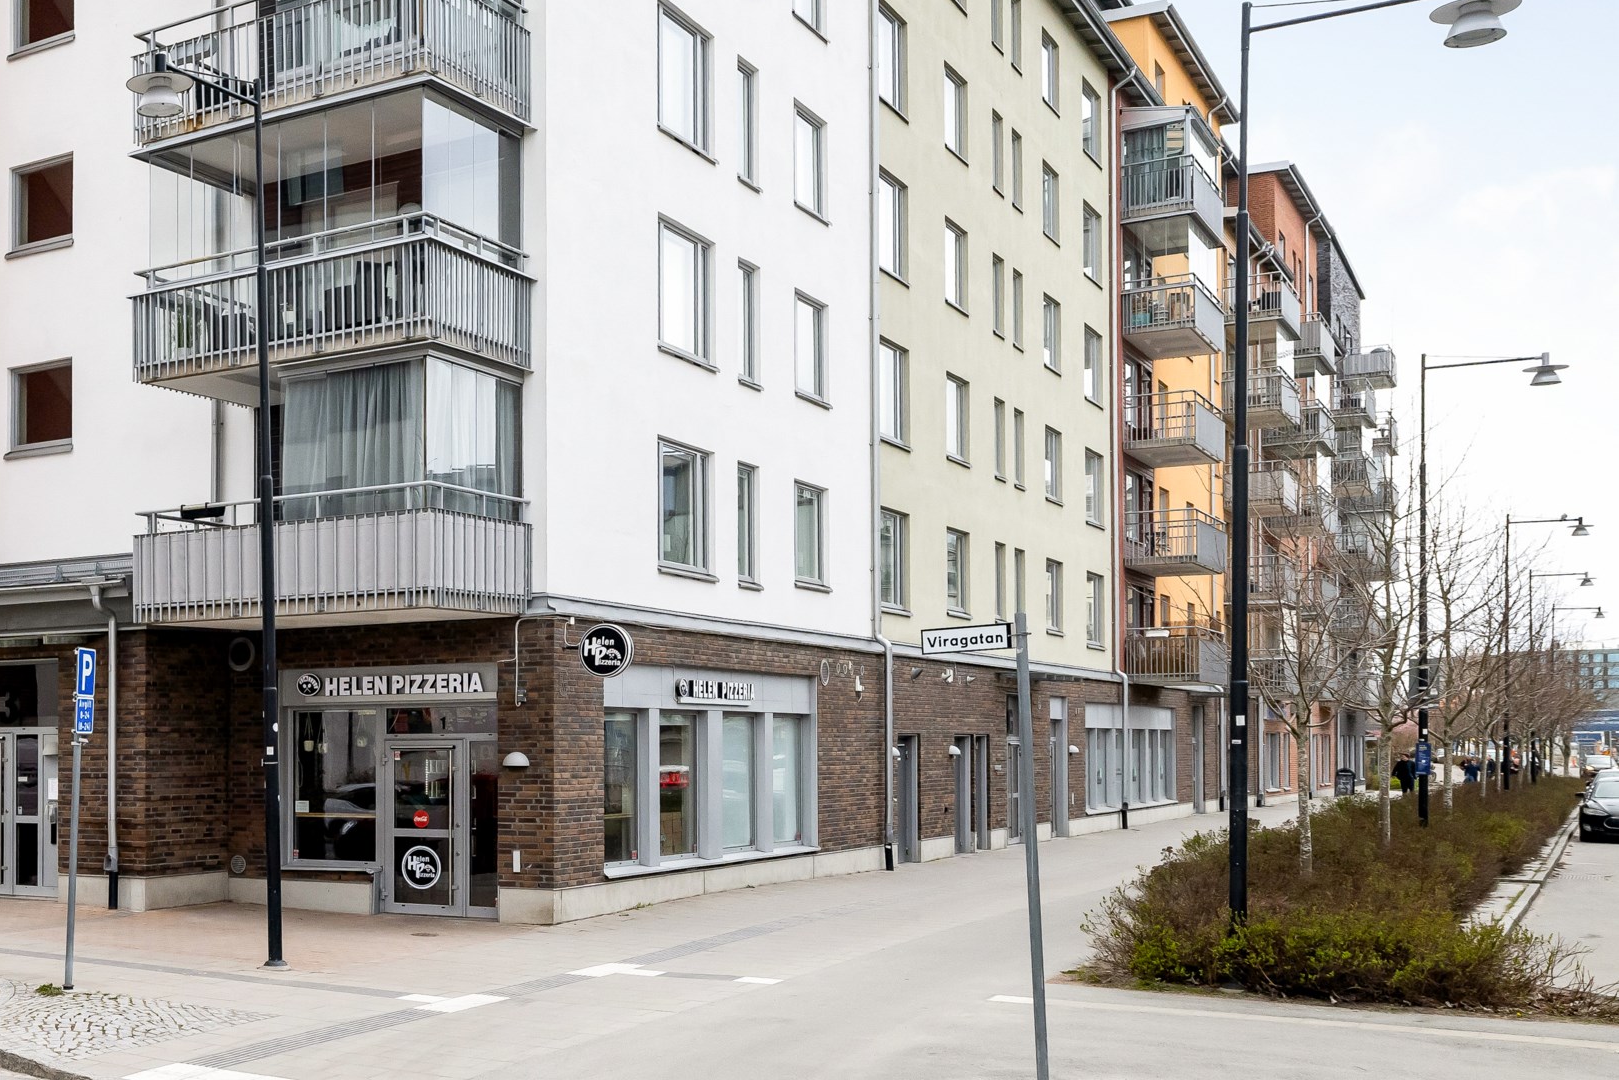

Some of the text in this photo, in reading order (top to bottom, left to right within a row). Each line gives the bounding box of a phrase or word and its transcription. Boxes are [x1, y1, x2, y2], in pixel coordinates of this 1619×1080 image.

[583, 635, 615, 657] Helen
[926, 633, 1004, 648] Viragatan
[594, 646, 621, 666] Pizzeria
[81, 653, 93, 691] P
[324, 672, 483, 697] HELEN PIZZERIA
[693, 679, 755, 700] HELEN PIZZERIA
[78, 700, 92, 710] Avgift
[440, 716, 446, 730] 1
[407, 855, 430, 870] Helen
[415, 862, 436, 878] Pizzeria
